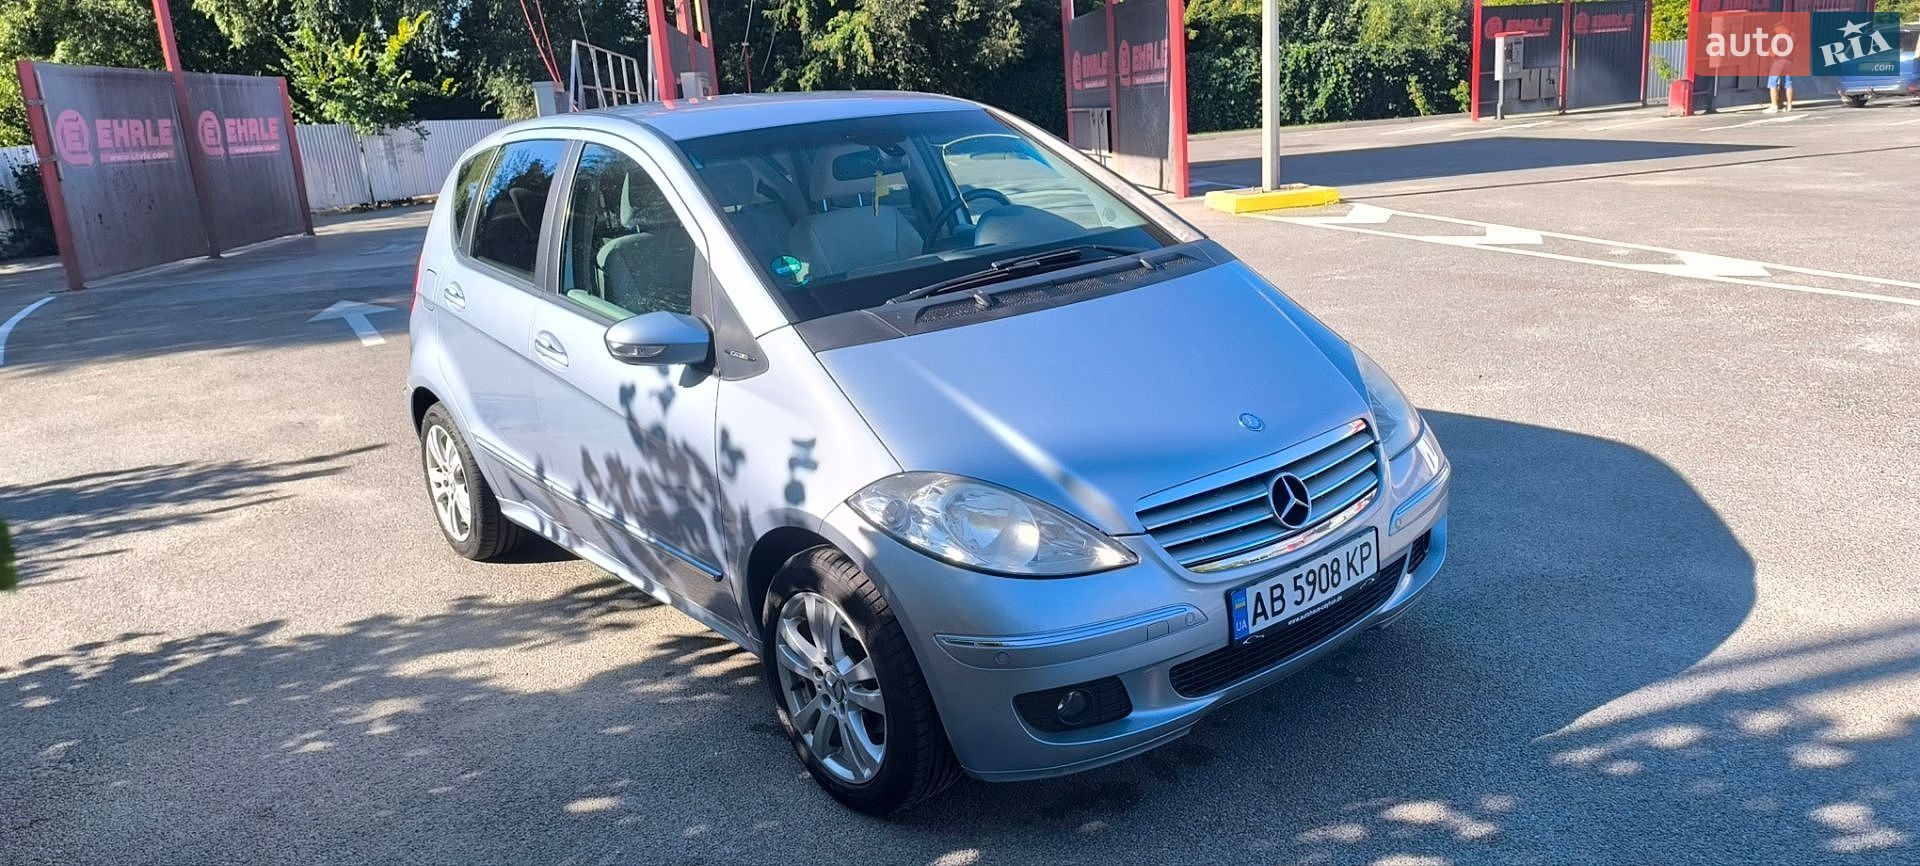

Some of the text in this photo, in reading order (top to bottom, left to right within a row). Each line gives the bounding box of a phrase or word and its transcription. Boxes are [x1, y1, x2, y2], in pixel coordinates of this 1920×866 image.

[1131, 39, 1168, 72] EHRLE
[95, 118, 174, 148] EHRLE
[224, 117, 280, 143] EHRLE
[1251, 541, 1372, 627] AB 5908 KP
[1235, 619, 1248, 632] UA
